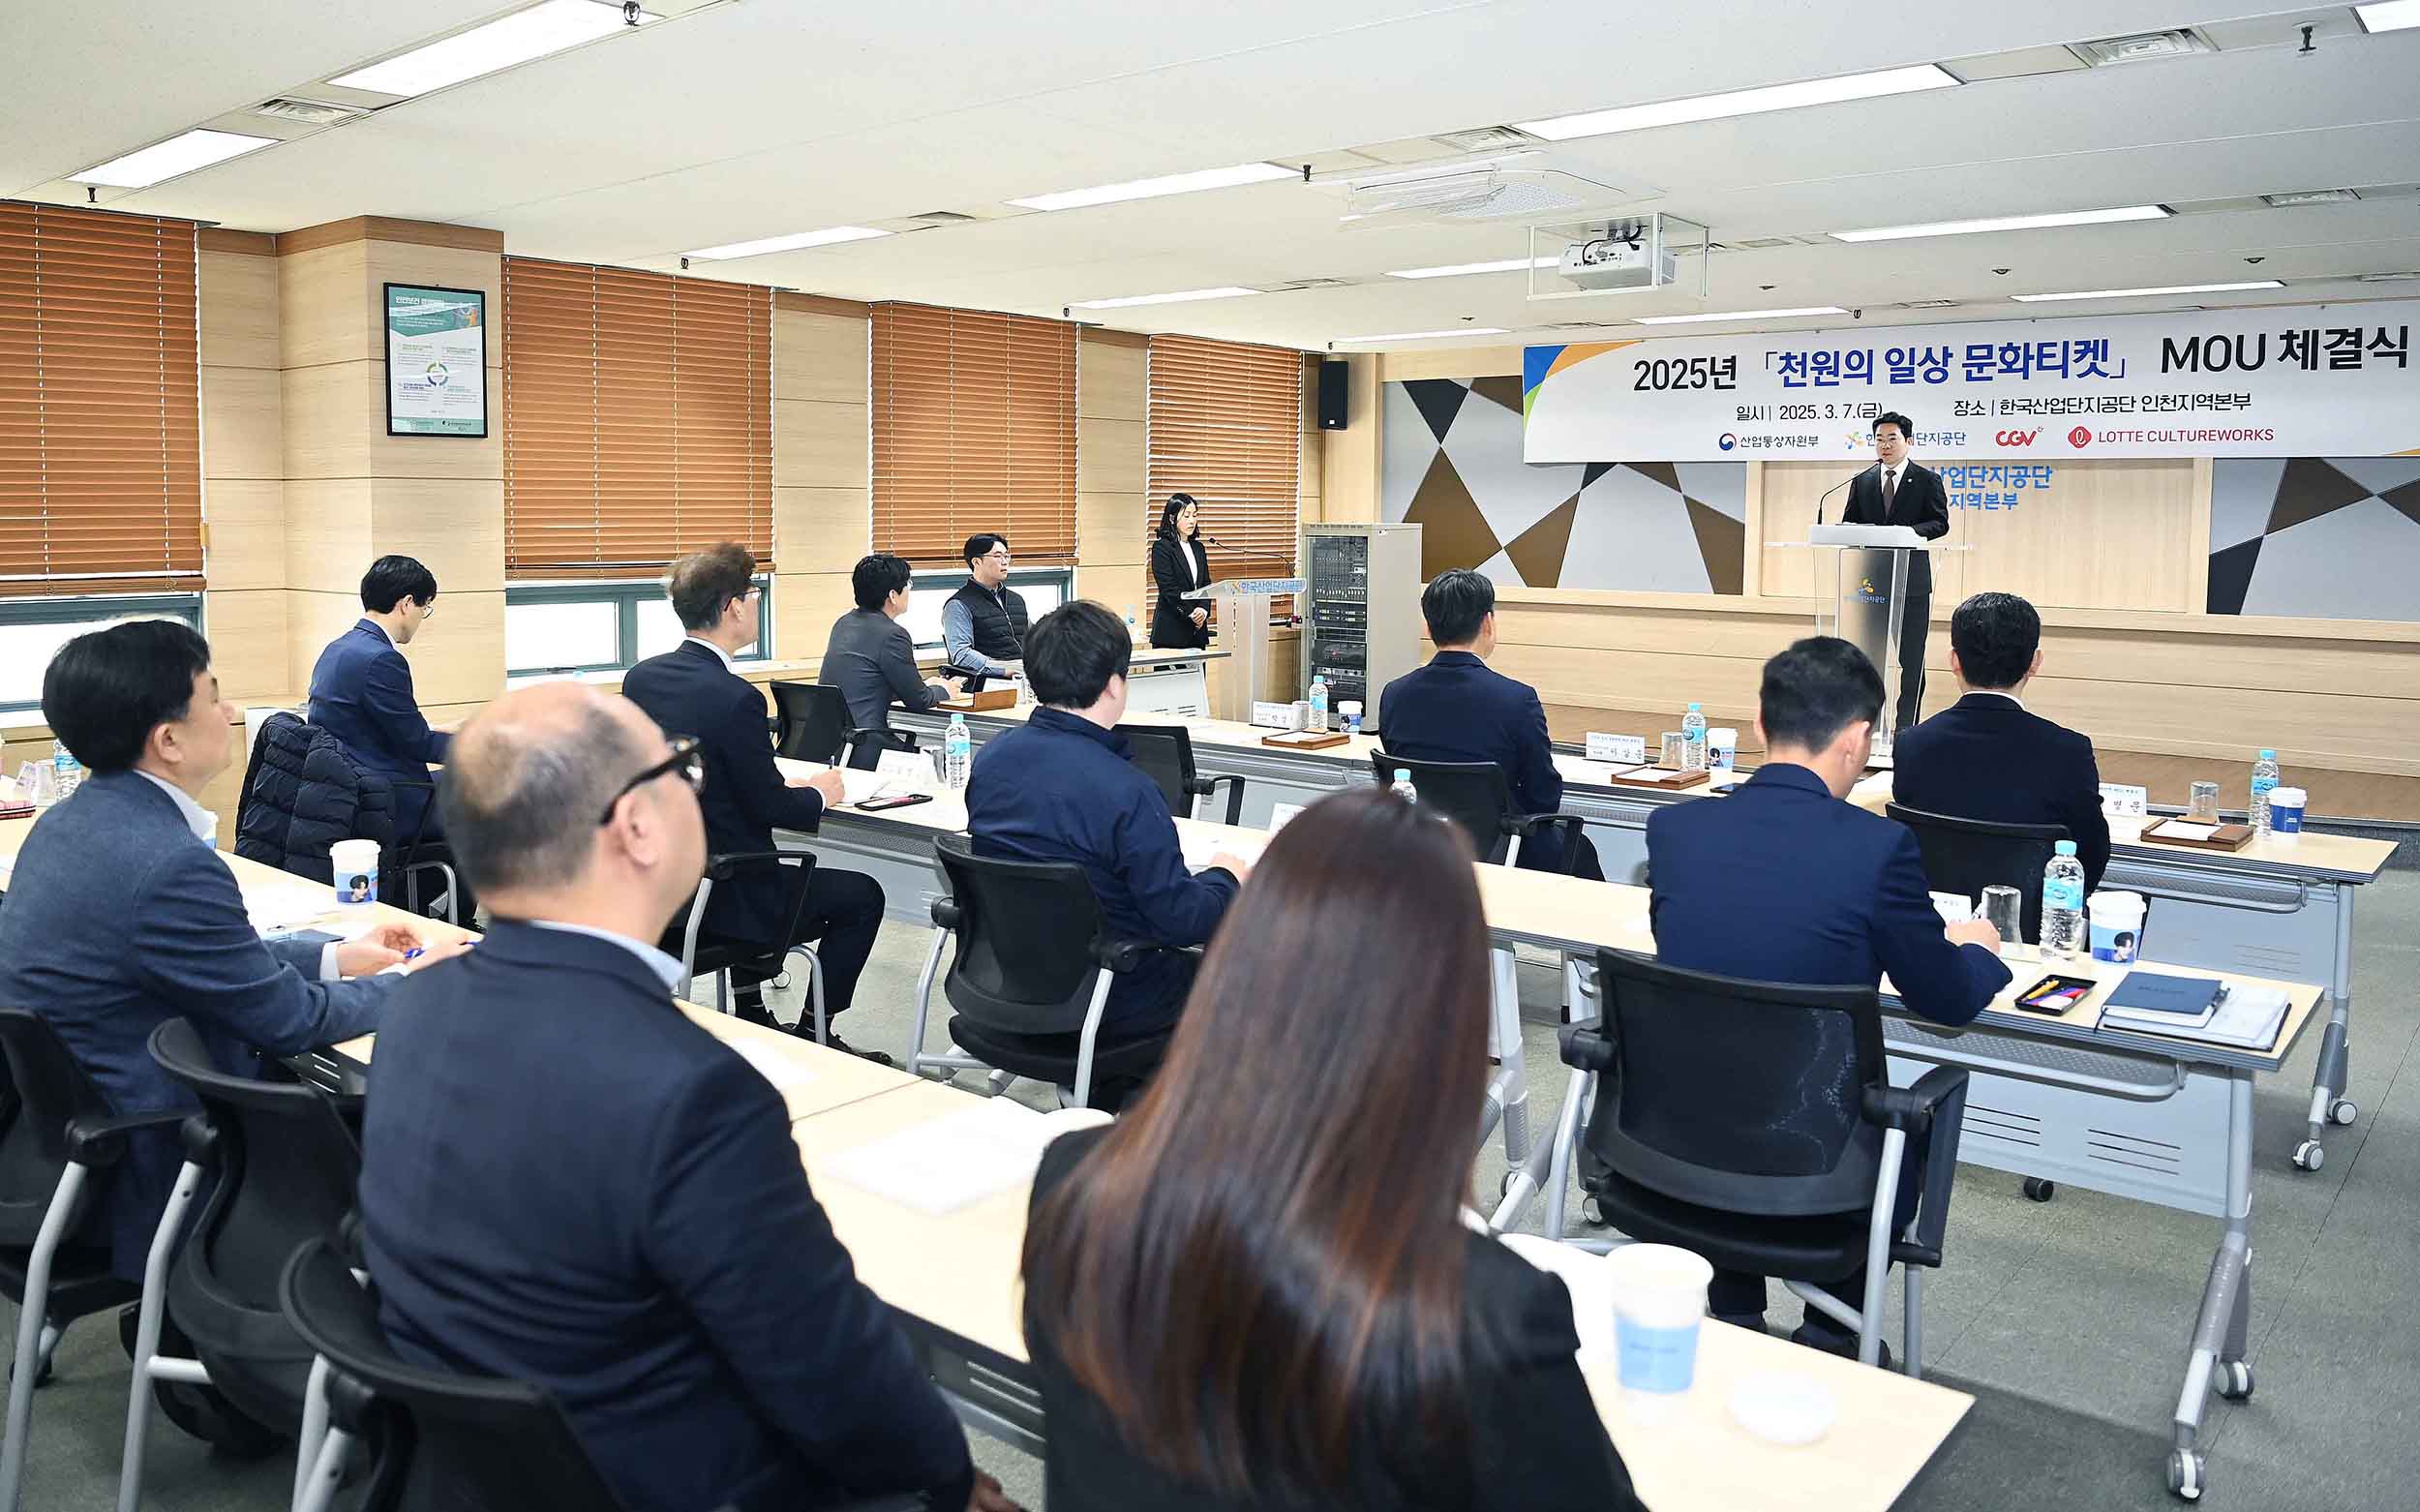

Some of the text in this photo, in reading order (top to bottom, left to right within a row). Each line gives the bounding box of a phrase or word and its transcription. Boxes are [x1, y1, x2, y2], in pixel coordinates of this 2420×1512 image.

[1633, 354, 1738, 391] 2025년
[1884, 346, 1953, 385] 일상
[2161, 333, 2267, 374] MOU
[2278, 325, 2409, 371] 체결식
[1779, 405, 1821, 420] 2025.
[1953, 399, 1986, 417] 장소
[1999, 395, 2137, 416] 한국산업단지공단
[2141, 392, 2252, 412] 인천지역본부
[1740, 435, 1819, 448] 산업통상자원부
[1995, 429, 2038, 447] CGV
[2099, 429, 2275, 443] LOTTE CULTUREWORKS
[1932, 465, 2053, 489] 업단지공단
